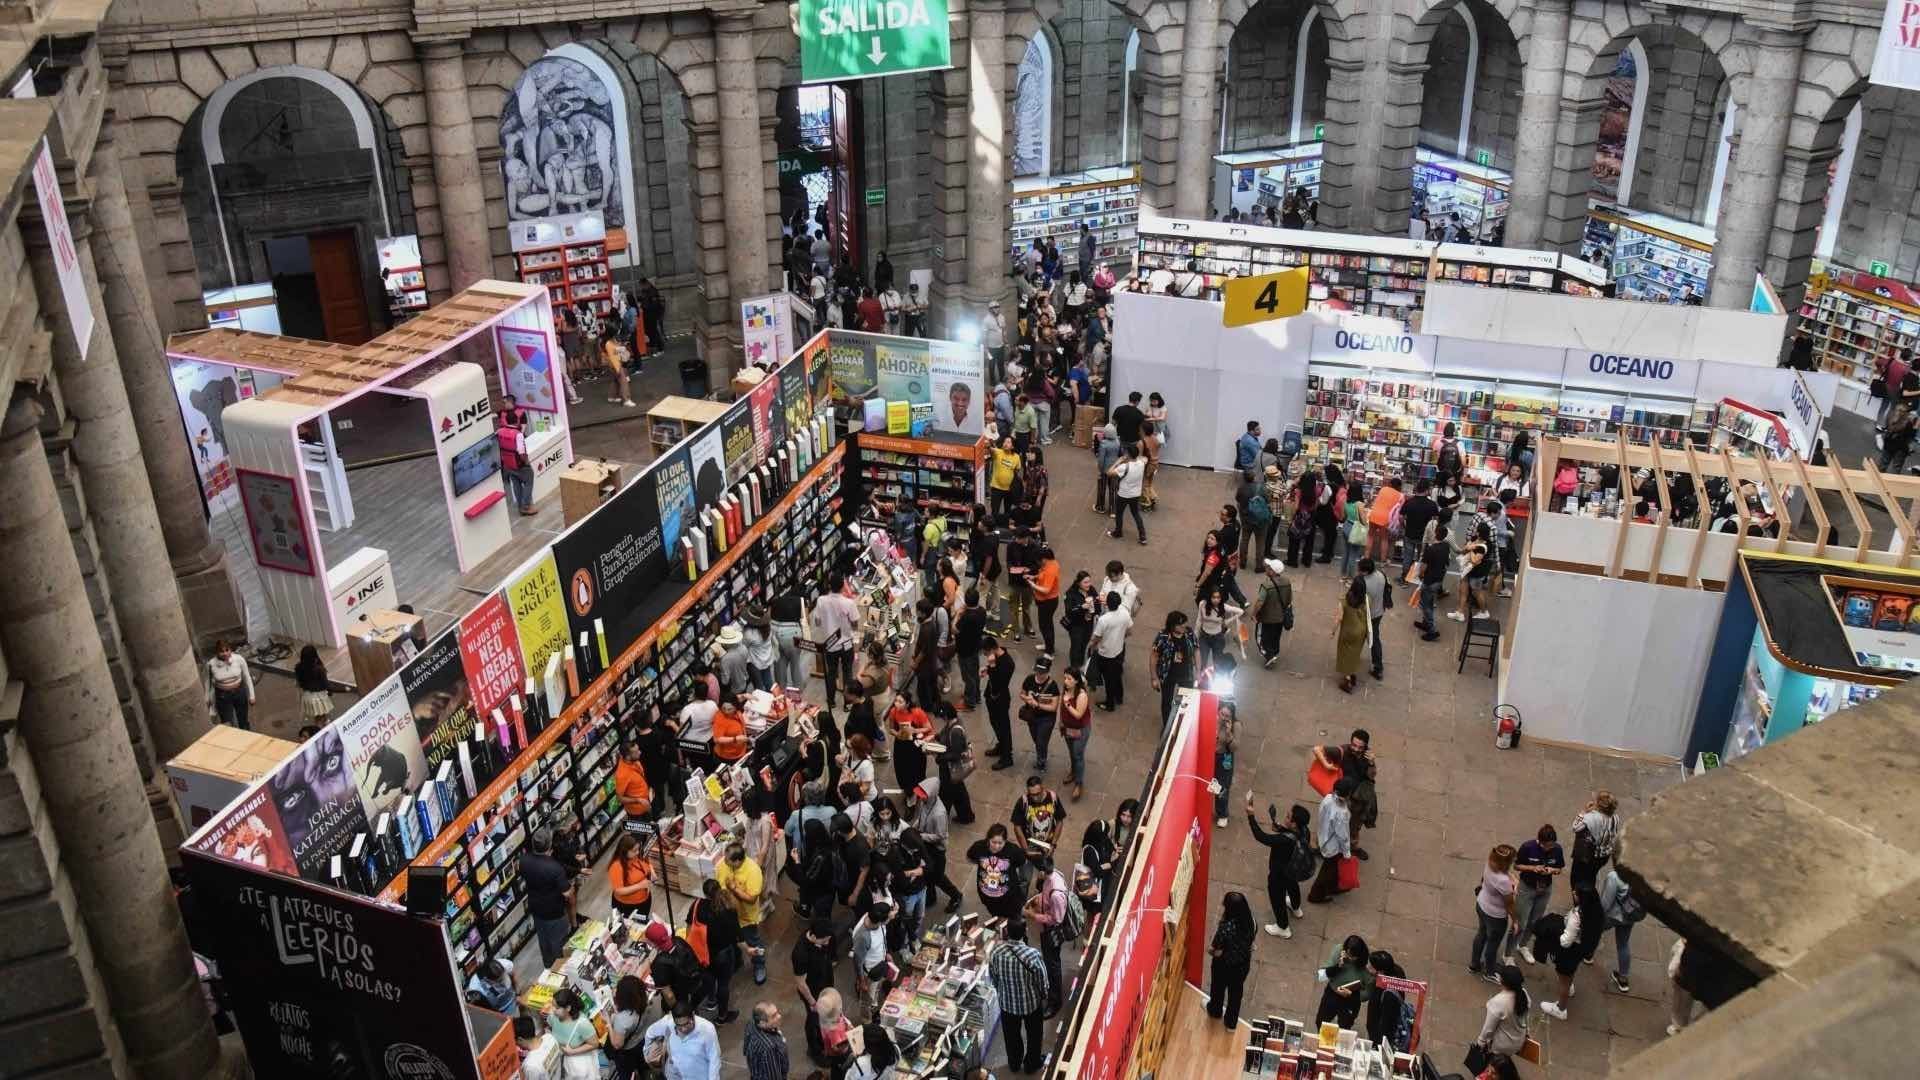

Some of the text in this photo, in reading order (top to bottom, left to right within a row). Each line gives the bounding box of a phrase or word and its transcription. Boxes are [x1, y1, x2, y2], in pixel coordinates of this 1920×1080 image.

[819, 0, 930, 35] SALIDA
[1254, 280, 1279, 314] 4
[1335, 330, 1413, 353] OCEANO
[831, 355, 864, 366] GANAR
[878, 358, 929, 376] AHORA
[1589, 353, 1674, 380] OCEANO
[457, 398, 489, 425] INE
[1791, 379, 1812, 425] OCEANO
[544, 448, 563, 467] INE
[656, 469, 668, 485] LO
[600, 533, 634, 566] Penguin
[601, 526, 659, 579] Random House
[603, 534, 661, 592] Grupo Editorial
[358, 575, 385, 601] INE
[517, 580, 557, 622] SIGUE?
[467, 615, 506, 655] HIJOS DEL
[479, 634, 503, 667] NEO
[412, 645, 447, 677] FRANCISCO
[431, 647, 458, 673] MORENO
[475, 647, 515, 691] LIBERA
[480, 664, 519, 709] LISMO
[342, 681, 400, 733] Anamar Orihuela
[351, 712, 412, 769] HUEVOTES
[360, 711, 396, 746] DOÑA
[293, 793, 362, 859] KATZENBACH
[309, 797, 338, 830] JOHN
[239, 886, 266, 909] ¿TE
[284, 897, 354, 933] ATREVES
[268, 894, 376, 979] LEERLOS
[331, 965, 401, 1002] A SOLAS?
